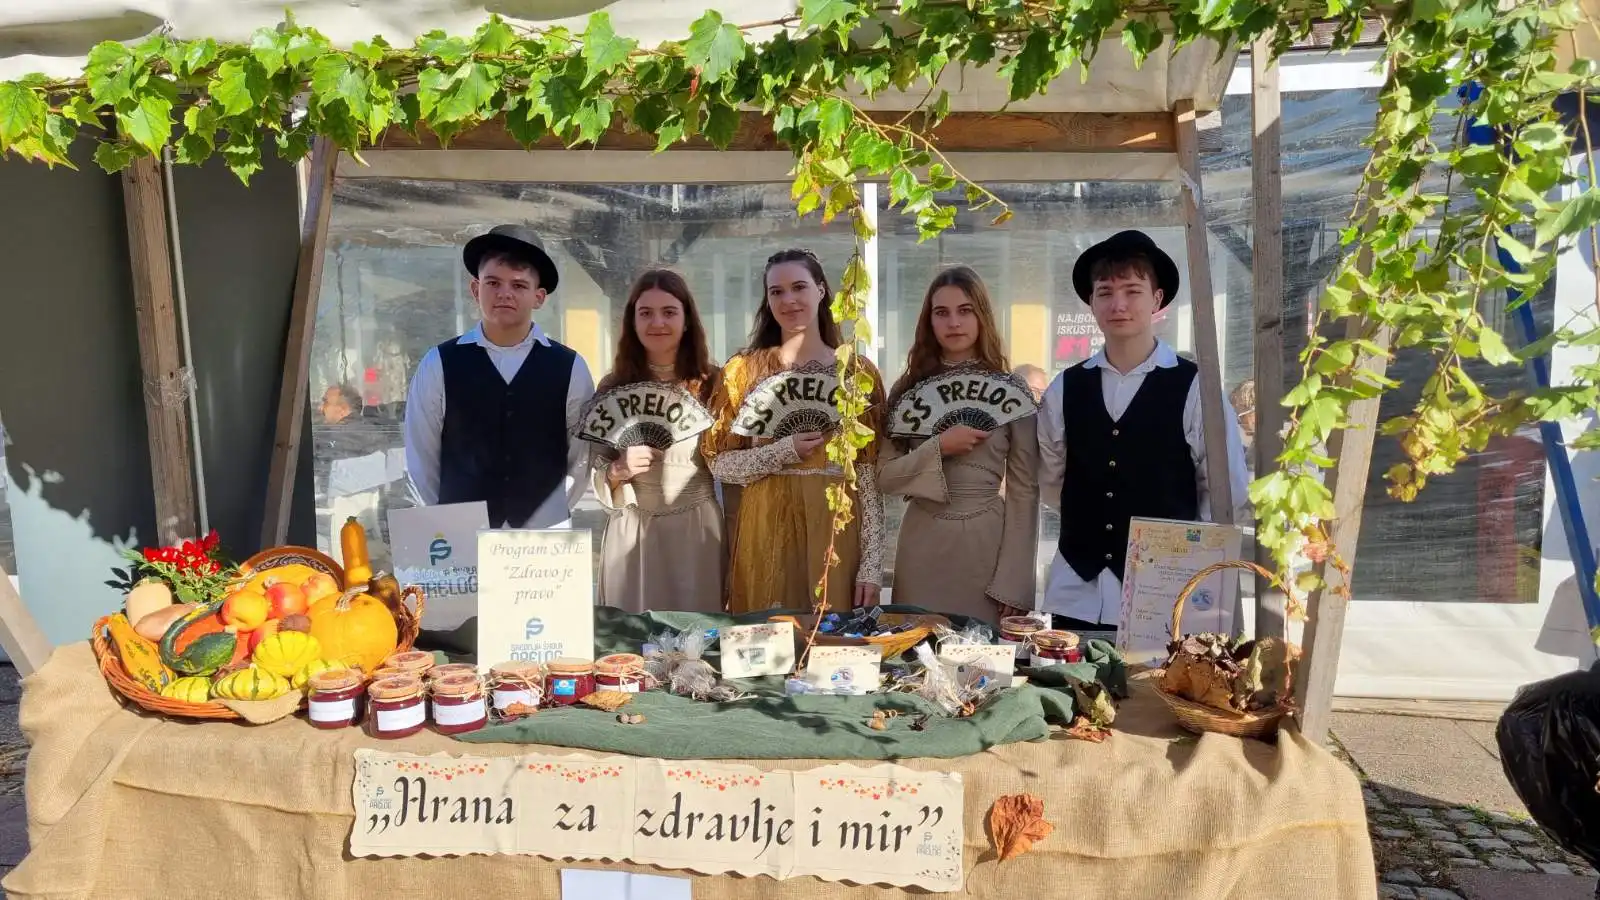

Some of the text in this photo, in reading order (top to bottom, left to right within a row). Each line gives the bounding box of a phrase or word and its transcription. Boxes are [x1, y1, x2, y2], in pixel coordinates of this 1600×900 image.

[774, 377, 841, 406] PRELO
[937, 380, 1021, 414] PRELOG
[590, 393, 697, 438] SŠ PRELOG
[489, 543, 548, 560] Program
[562, 566, 574, 581] je
[552, 802, 600, 832] za
[634, 792, 794, 859] zdravlje
[811, 807, 823, 847] i
